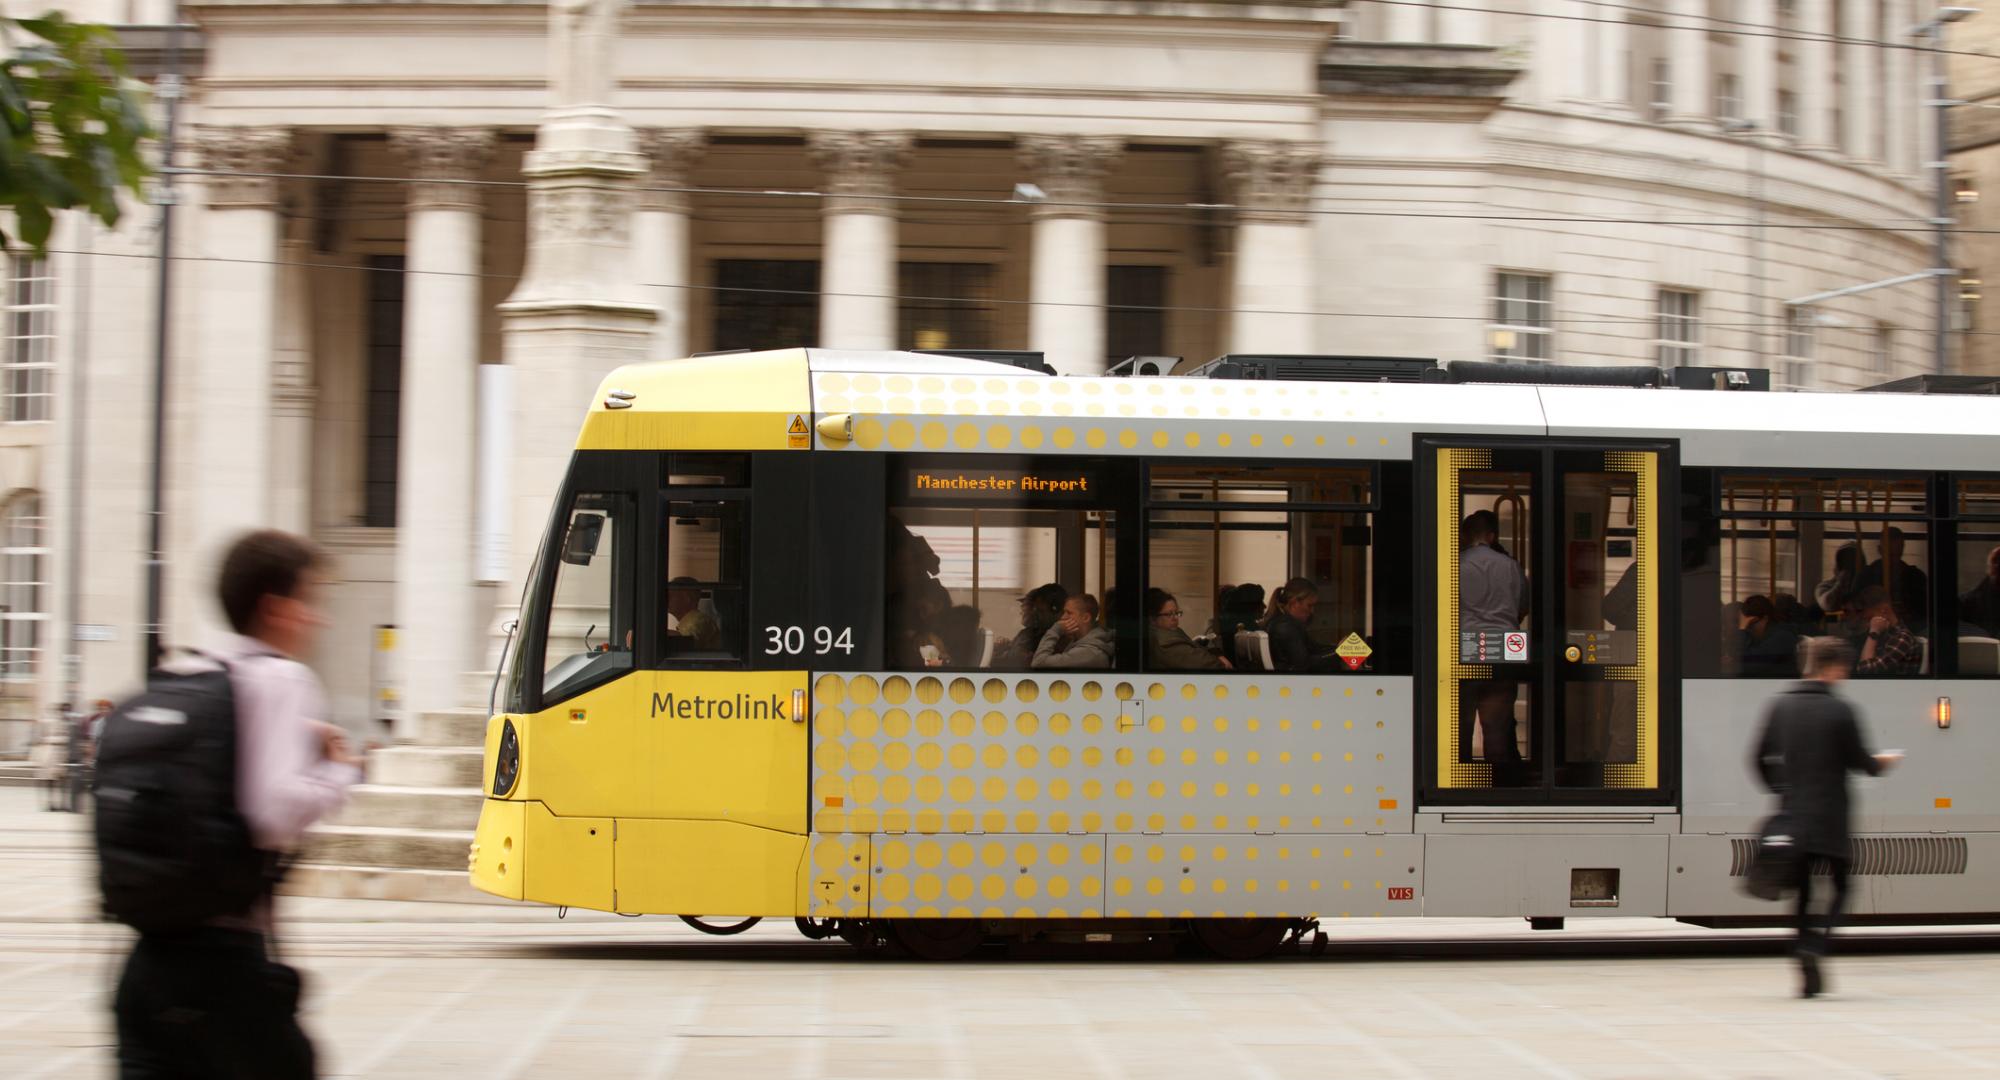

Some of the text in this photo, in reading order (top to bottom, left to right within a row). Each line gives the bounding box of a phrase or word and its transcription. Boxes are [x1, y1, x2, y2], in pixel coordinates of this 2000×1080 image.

[916, 475, 1088, 492] Manchester Airport
[651, 692, 786, 720] Metrolink
[1390, 888, 1411, 899] VIS
